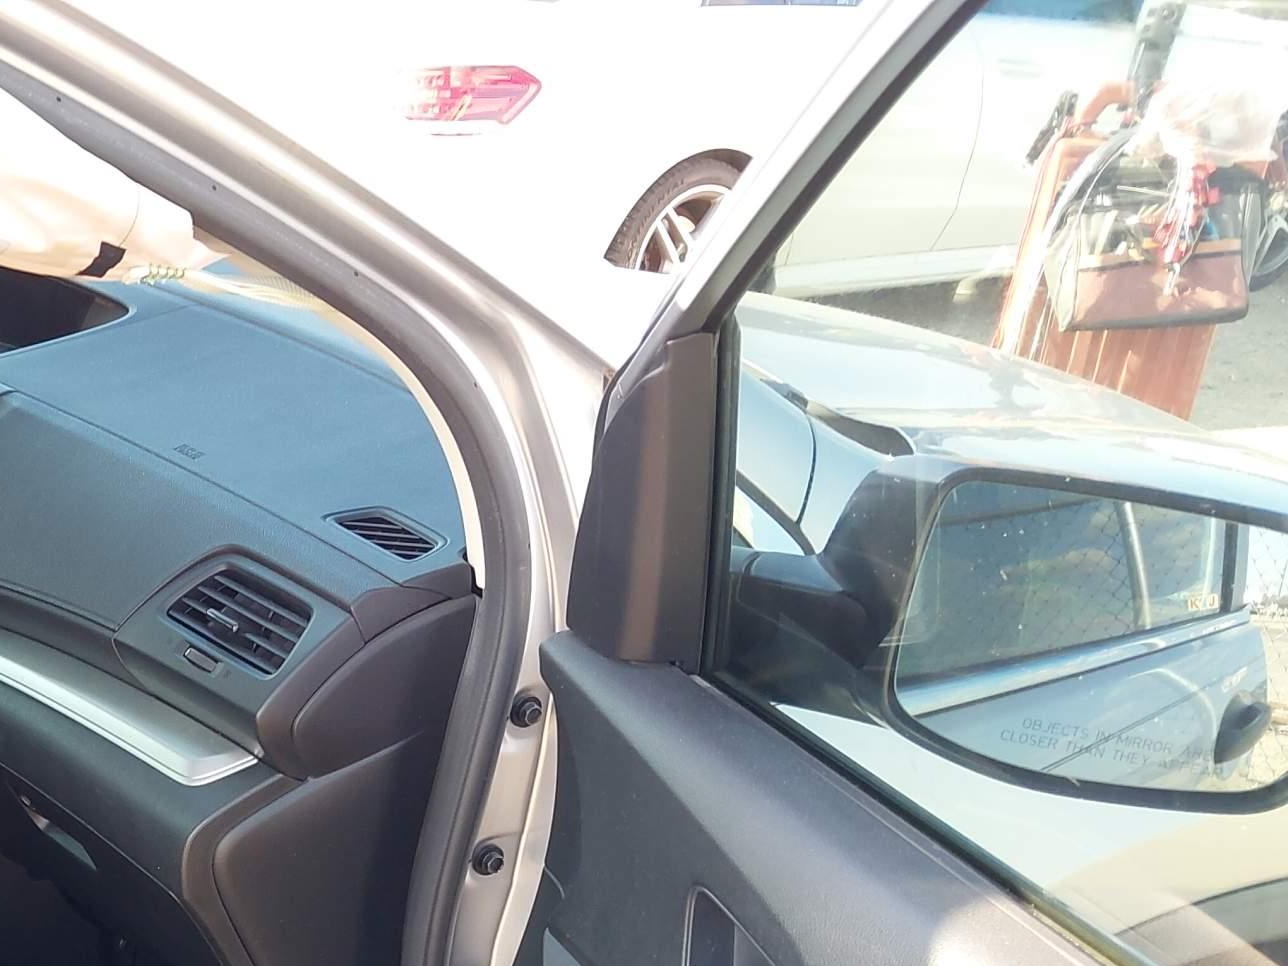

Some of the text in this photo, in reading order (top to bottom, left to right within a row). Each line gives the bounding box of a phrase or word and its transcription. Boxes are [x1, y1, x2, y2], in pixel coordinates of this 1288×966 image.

[1000, 728, 1059, 750] CLOSER
[1065, 740, 1106, 759] THAN
[1113, 749, 1149, 766] THEY
[1022, 718, 1089, 739] OBJECTS
[1096, 730, 1112, 742] IN
[1118, 734, 1173, 753] MIRROR
